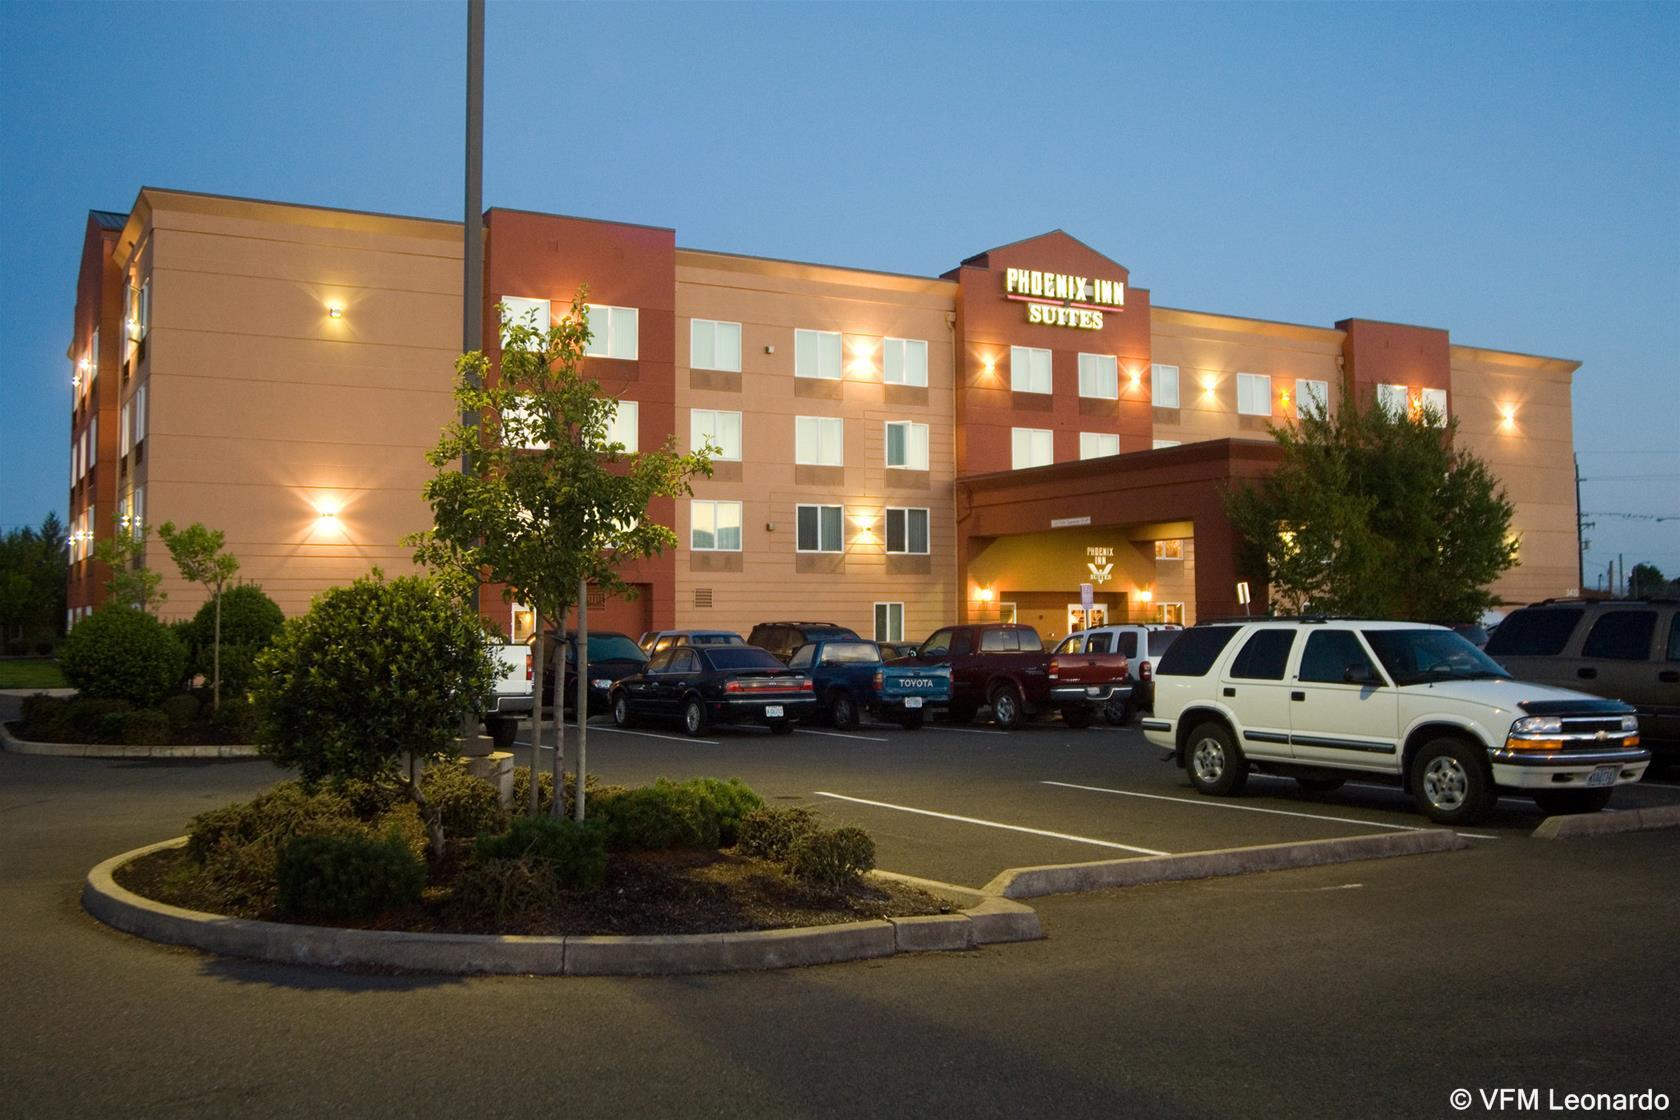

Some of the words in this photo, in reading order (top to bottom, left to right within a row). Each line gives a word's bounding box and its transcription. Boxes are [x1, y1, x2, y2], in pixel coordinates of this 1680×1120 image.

[1006, 267, 1088, 302] PHOENIX
[1094, 278, 1125, 306] INN
[1027, 302, 1105, 331] SUITES
[1086, 546, 1114, 556] PHOENIX
[1094, 556, 1107, 565] INN
[899, 679, 934, 688] TOYOTA
